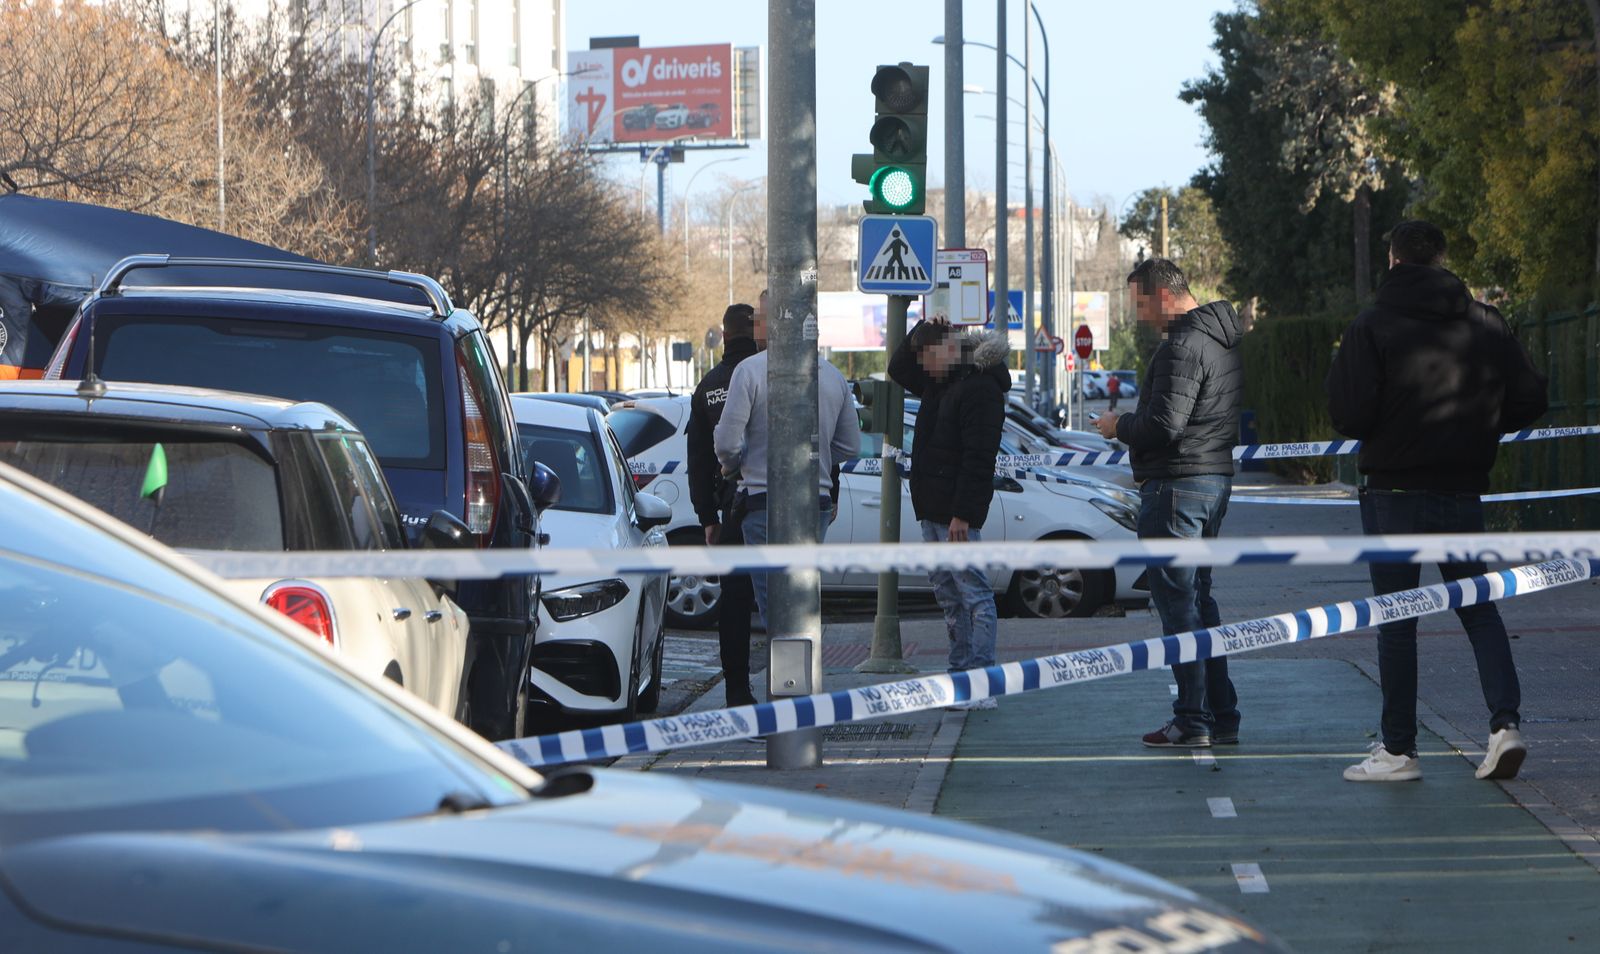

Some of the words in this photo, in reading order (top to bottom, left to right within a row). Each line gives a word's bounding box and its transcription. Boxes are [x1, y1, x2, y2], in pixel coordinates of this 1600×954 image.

[653, 56, 722, 80] driveris
[950, 268, 961, 277] A8
[1076, 338, 1091, 346] STOP
[706, 388, 729, 399] POL
[707, 395, 727, 405] NAC
[1555, 428, 1582, 436] PASAR
[1538, 559, 1570, 575] PASAR
[1545, 574, 1554, 585] DE
[1555, 570, 1578, 583] POLICIA
[1375, 595, 1393, 609] NO
[1393, 589, 1428, 605] PASAR
[1382, 608, 1400, 620] LINEA
[1400, 605, 1411, 617] DE
[1410, 600, 1435, 614] POLICIA
[1217, 625, 1237, 639] NO
[1237, 619, 1274, 636] PASAR
[1224, 639, 1244, 652] LINEA
[1245, 636, 1256, 648] DE
[1255, 630, 1282, 645] POLICIA
[1046, 656, 1067, 670] NO
[1068, 650, 1107, 667] PASAR
[1053, 669, 1075, 683] LINEA
[1075, 667, 1088, 679] DE
[1087, 662, 1116, 676] POLICIA
[858, 687, 881, 701] NO
[883, 680, 926, 697] PASAR
[867, 700, 892, 714] LINEA
[891, 699, 902, 710] DE
[904, 694, 936, 707] POLICIA
[654, 719, 678, 734] NO
[680, 712, 726, 730] PASAR
[663, 734, 689, 745] LINEA
[689, 731, 702, 741] DE
[703, 725, 738, 740] POLICIA
